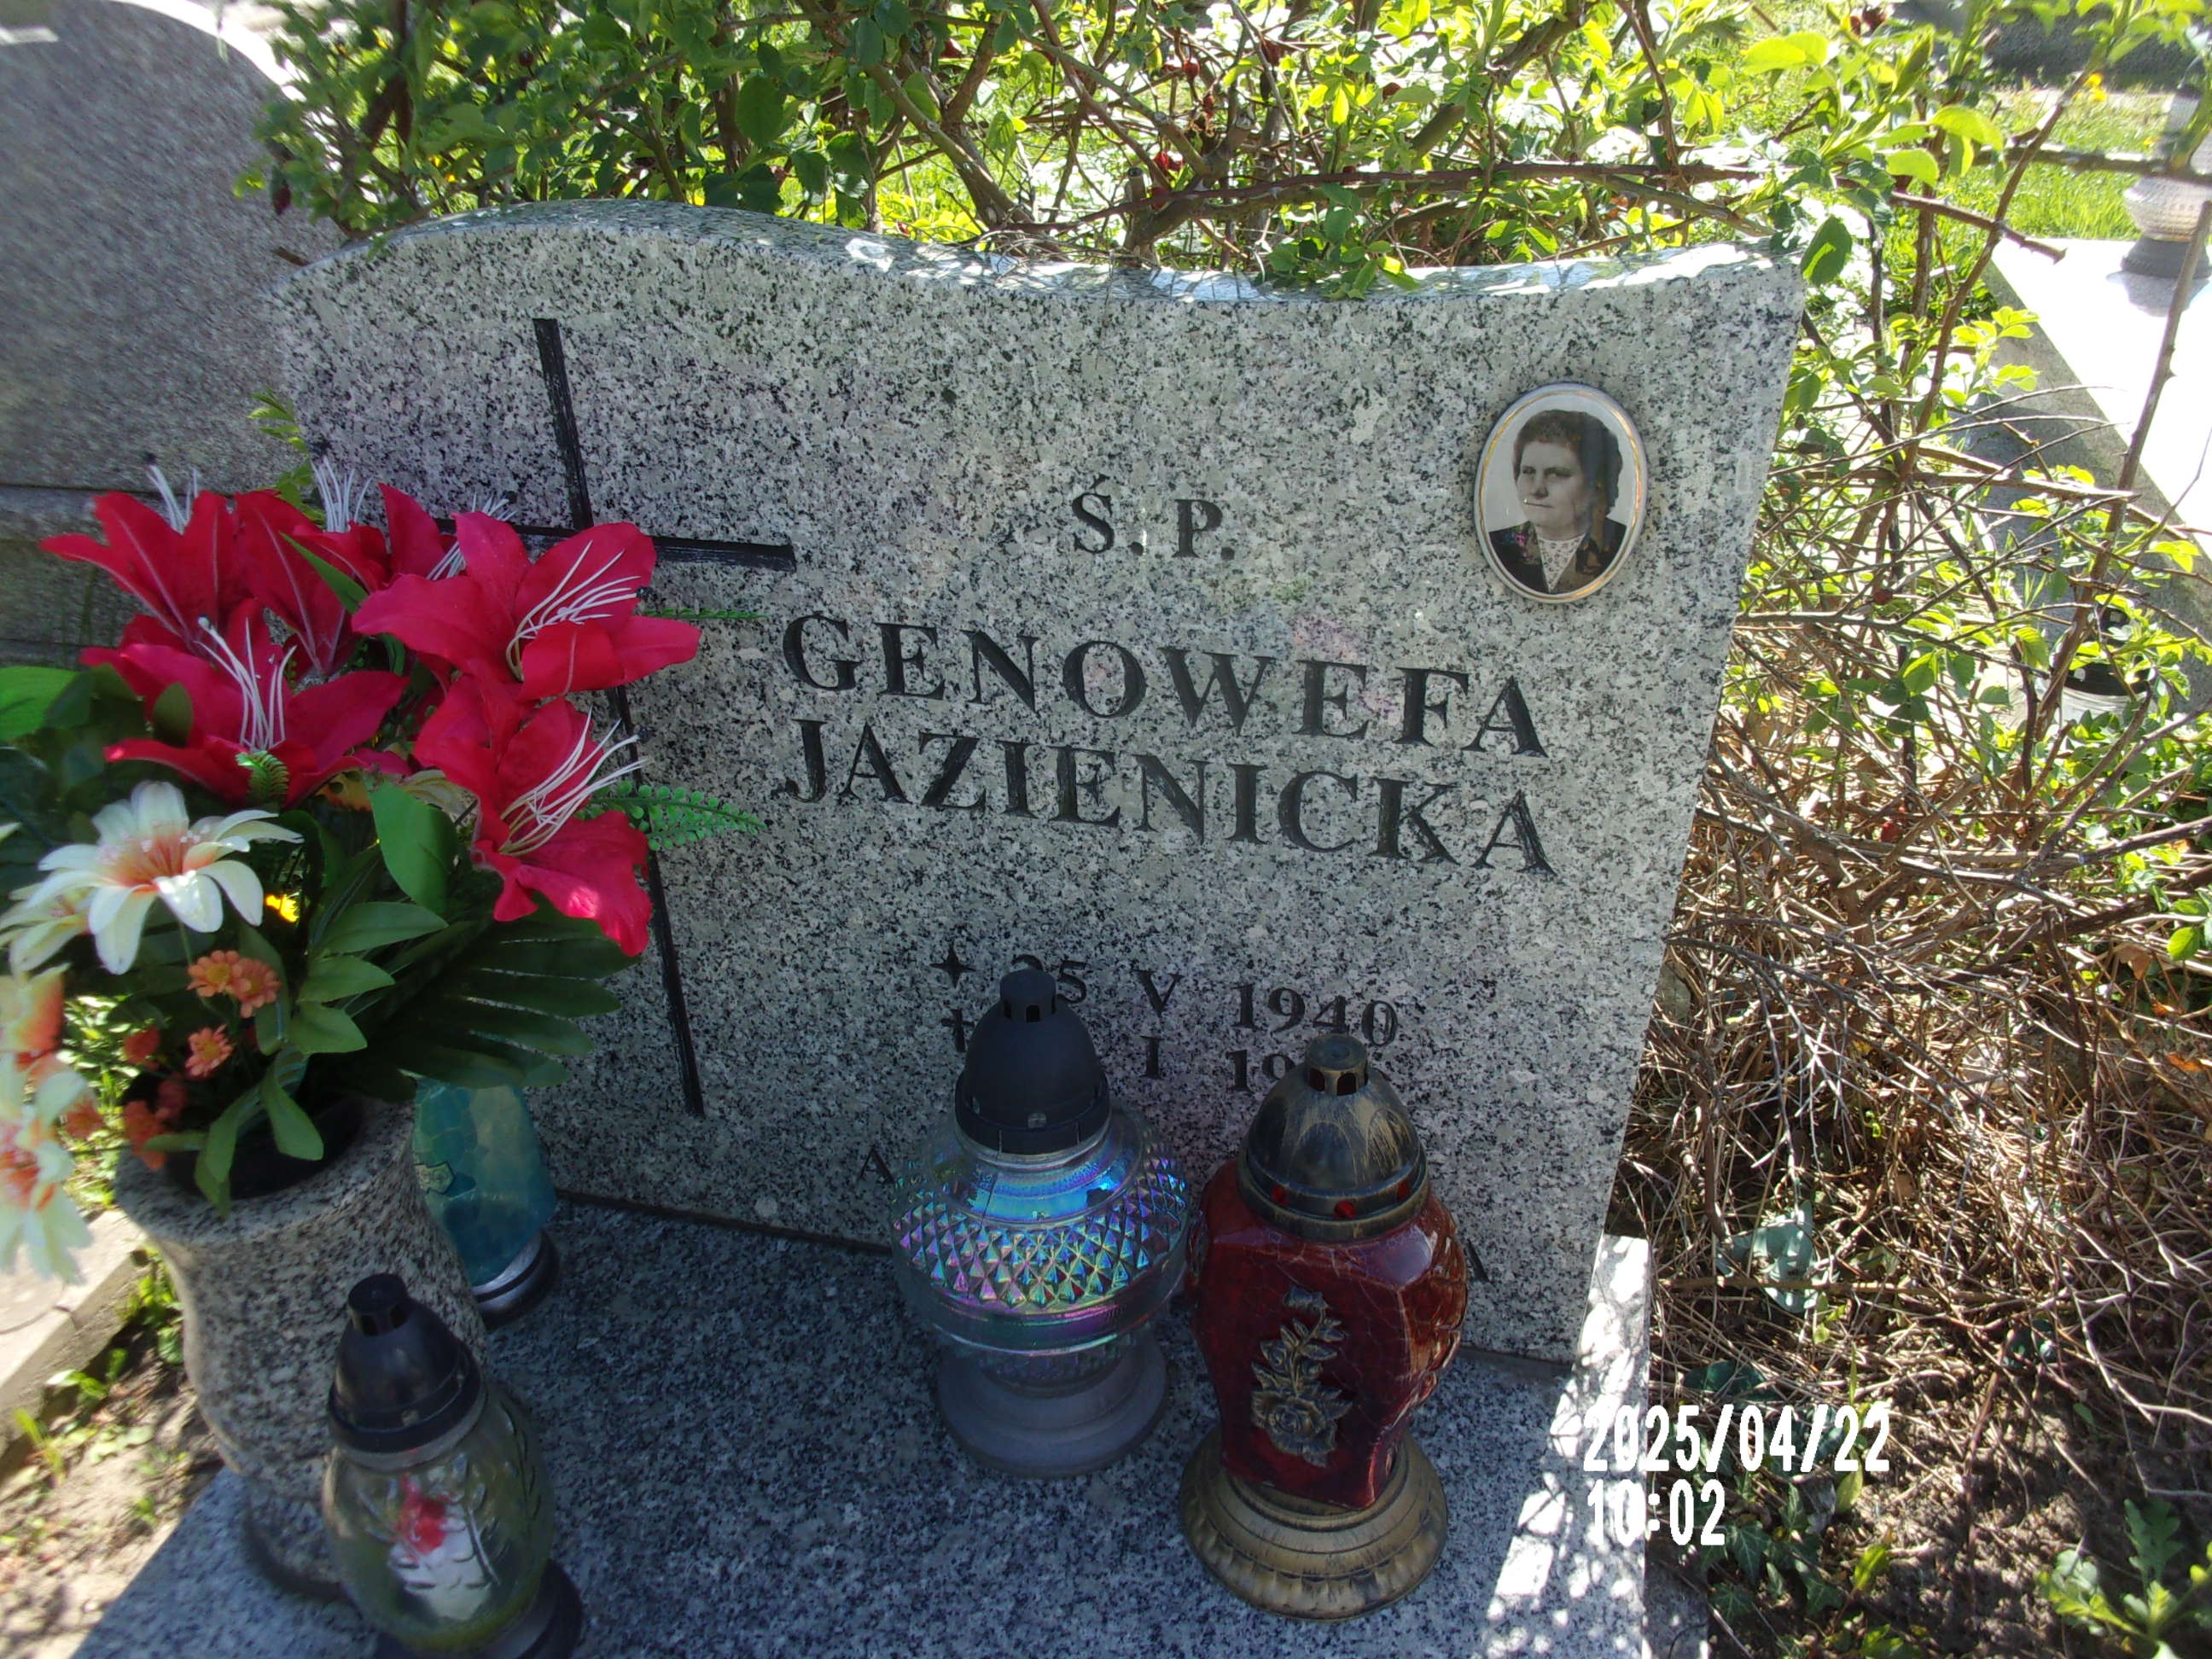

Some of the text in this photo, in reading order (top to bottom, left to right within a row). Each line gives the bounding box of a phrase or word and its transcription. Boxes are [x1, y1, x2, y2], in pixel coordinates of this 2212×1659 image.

[780, 613, 1549, 758] GENOWEFA
[778, 719, 1558, 876] JAZIENICKA
[1132, 969, 1185, 1021] V
[1229, 982, 1399, 1047] 1940
[1141, 1034, 1166, 1080] I
